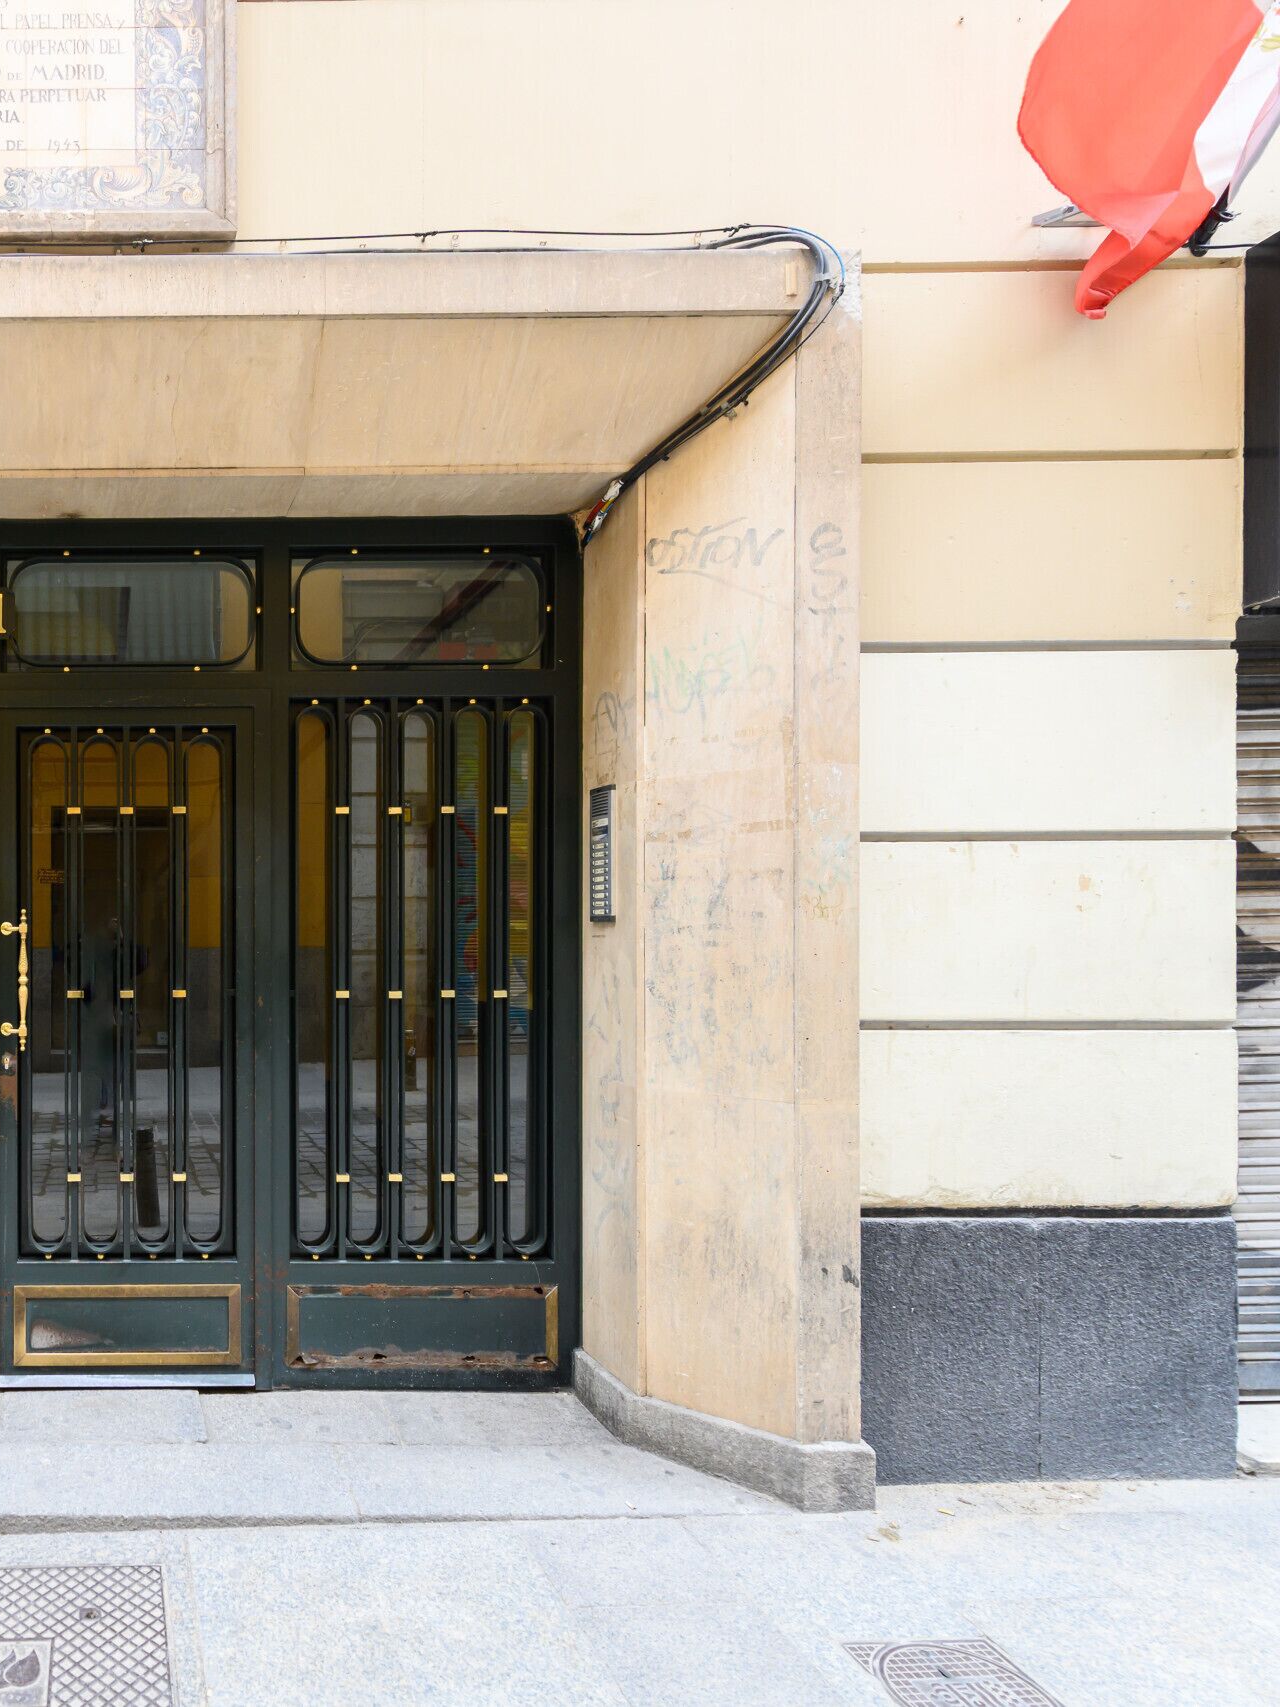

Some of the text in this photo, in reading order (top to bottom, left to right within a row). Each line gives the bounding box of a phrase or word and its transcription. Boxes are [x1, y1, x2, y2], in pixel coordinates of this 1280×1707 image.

[16, 13, 57, 29] PAPEL
[62, 12, 112, 28] PRENSA
[99, 38, 128, 54] DEL
[20, 88, 106, 103] PERPETUAR
[6, 140, 26, 151] DE
